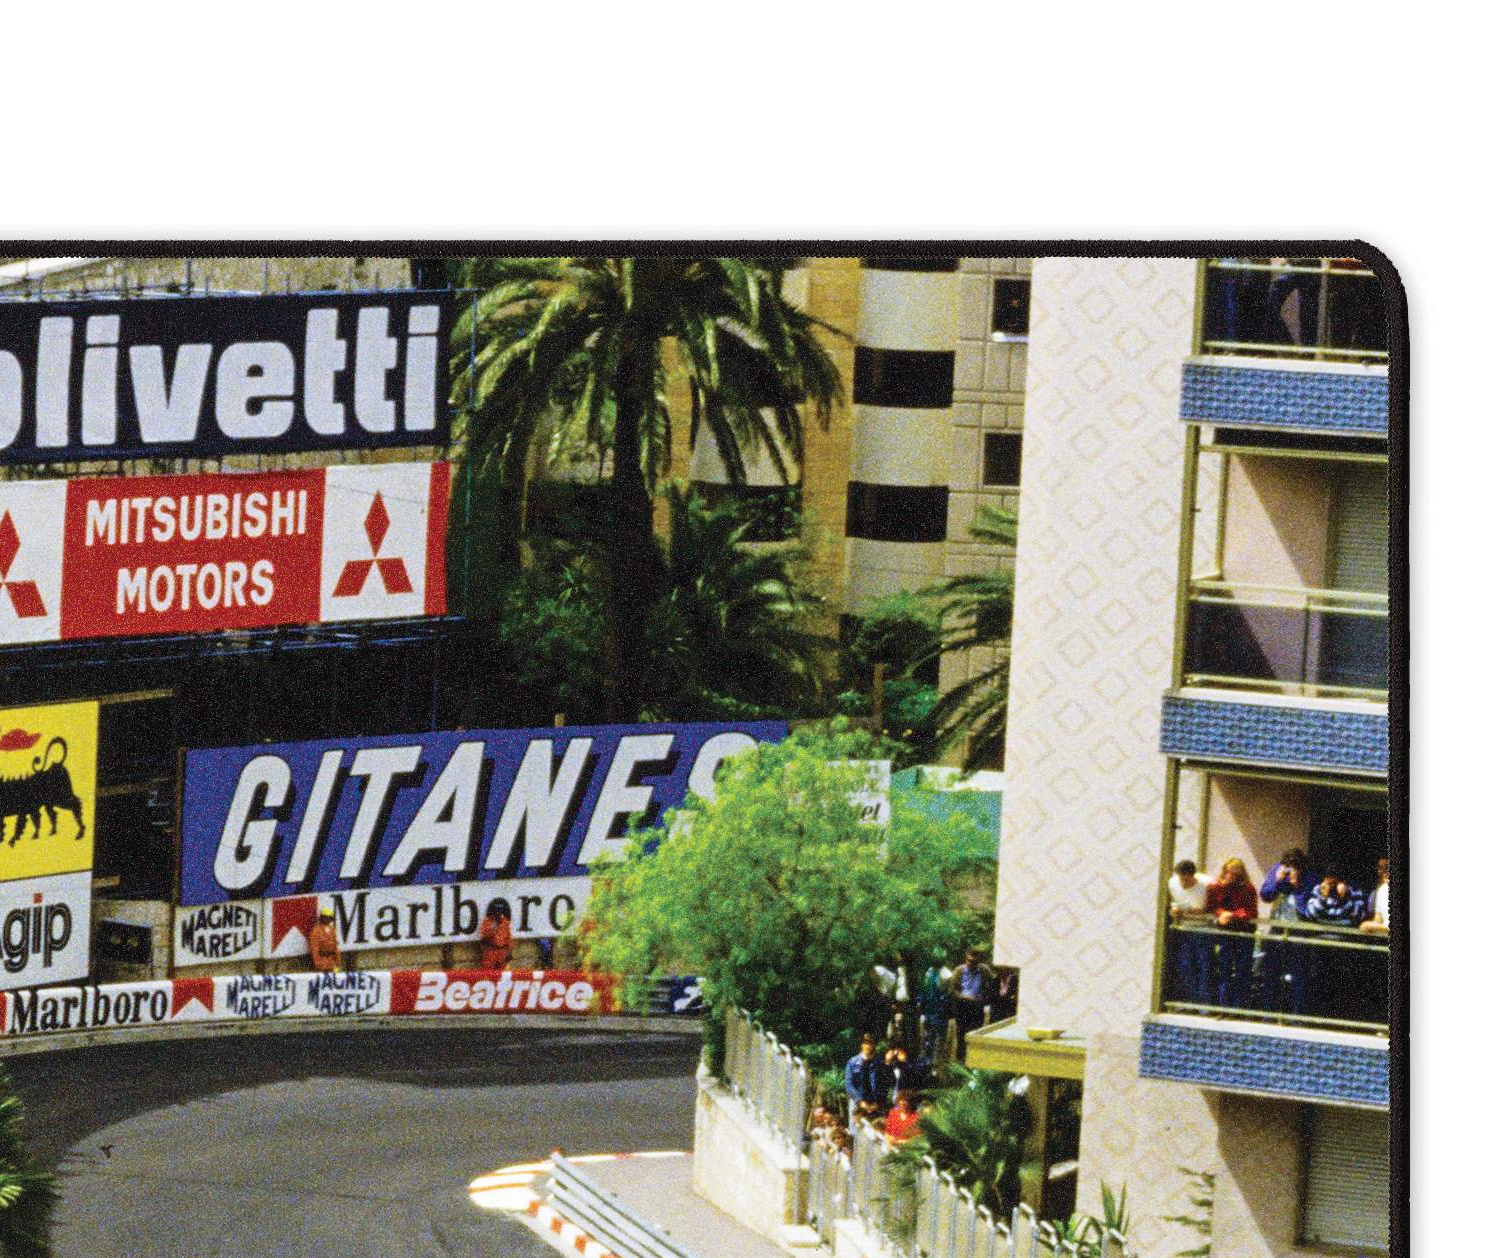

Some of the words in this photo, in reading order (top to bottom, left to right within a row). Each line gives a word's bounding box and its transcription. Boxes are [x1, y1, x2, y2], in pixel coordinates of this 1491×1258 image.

[84, 489, 309, 546] MITSUBISHI
[115, 559, 275, 615] MOTORS
[329, 886, 575, 945] Marlbro
[7, 979, 168, 1036] Marlboro
[415, 971, 594, 1012] Beatrice
